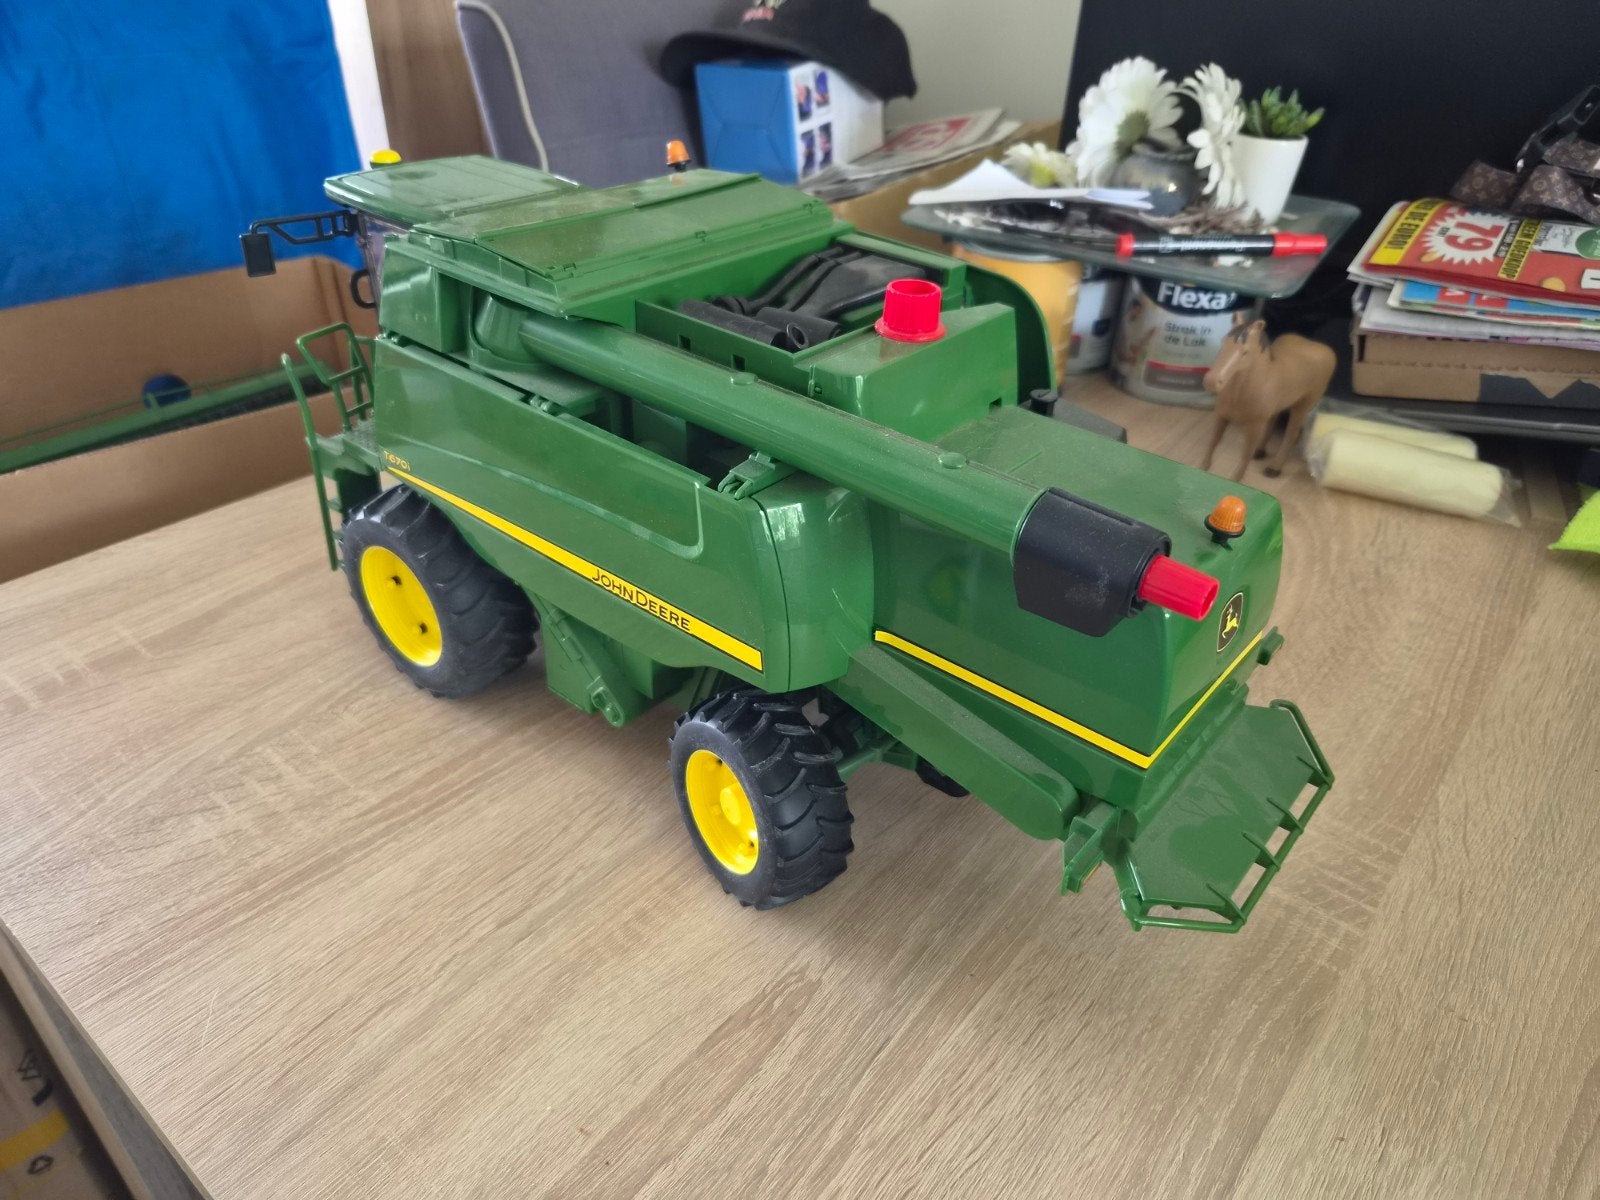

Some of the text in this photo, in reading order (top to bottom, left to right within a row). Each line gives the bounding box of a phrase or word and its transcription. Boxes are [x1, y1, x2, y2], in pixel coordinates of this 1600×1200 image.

[1445, 222, 1504, 251] 79
[1157, 281, 1229, 310] Flexa
[592, 569, 691, 631] JOHN DEERE
